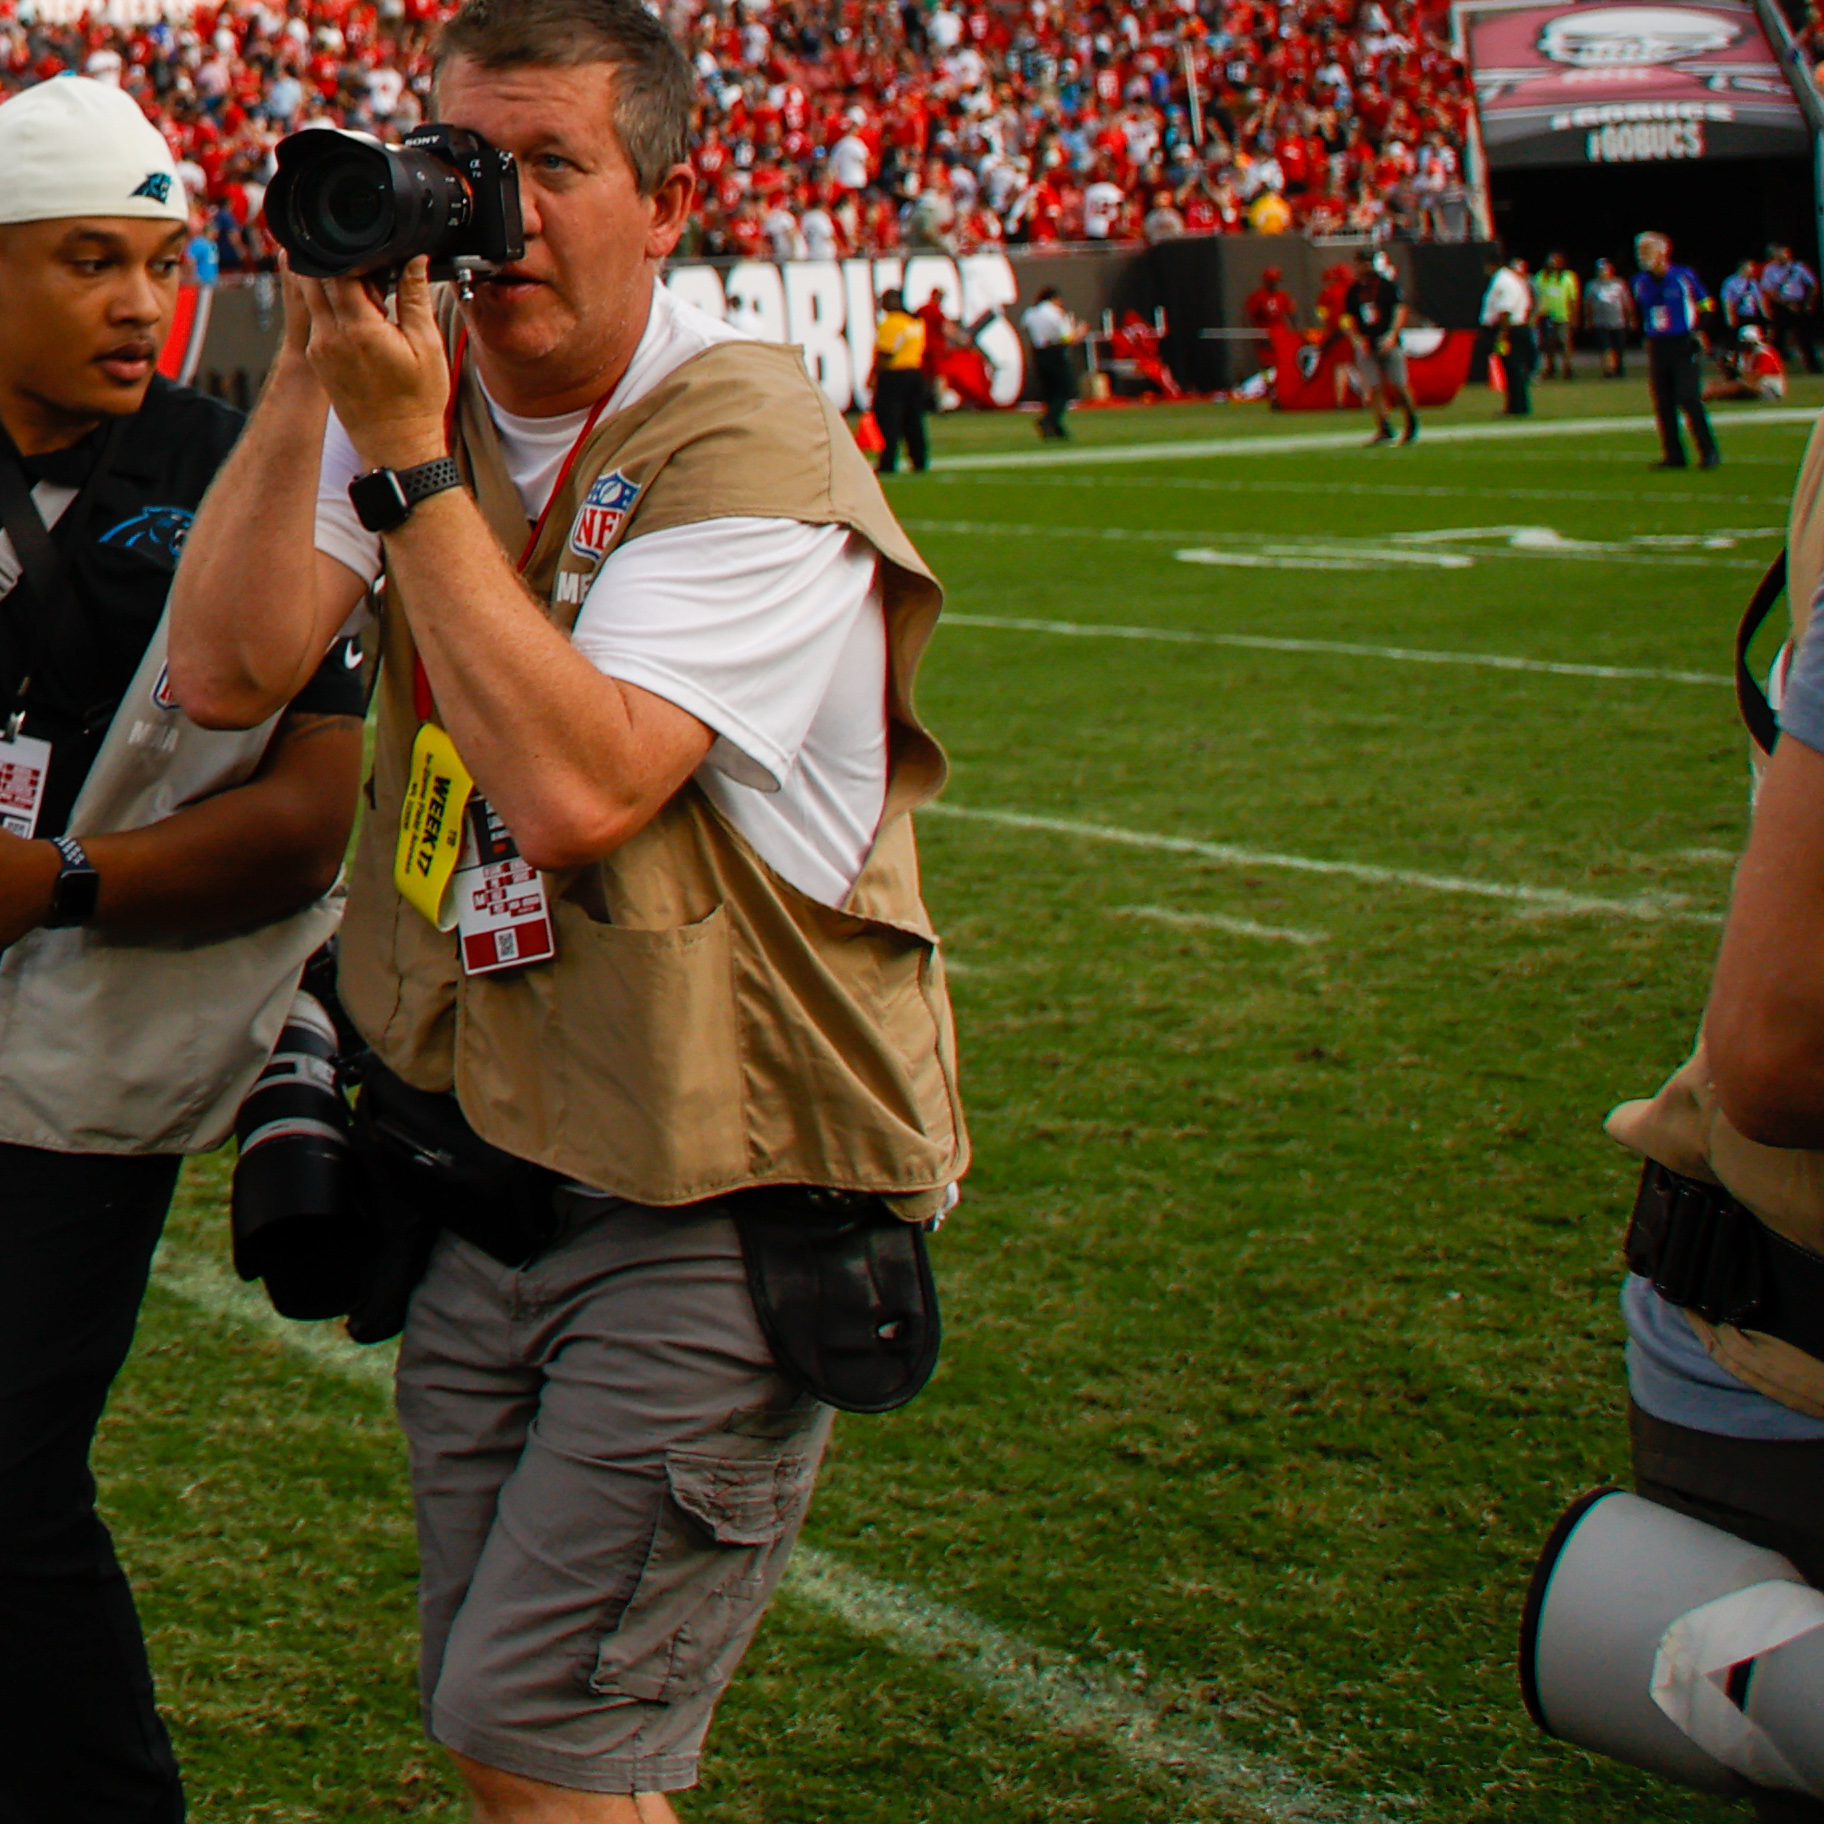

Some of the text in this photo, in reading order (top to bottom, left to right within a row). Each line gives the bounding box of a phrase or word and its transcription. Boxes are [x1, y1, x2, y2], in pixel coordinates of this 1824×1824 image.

[404, 135, 440, 147] SONY
[575, 507, 625, 551] NF
[418, 776, 451, 876] WEEK 17
